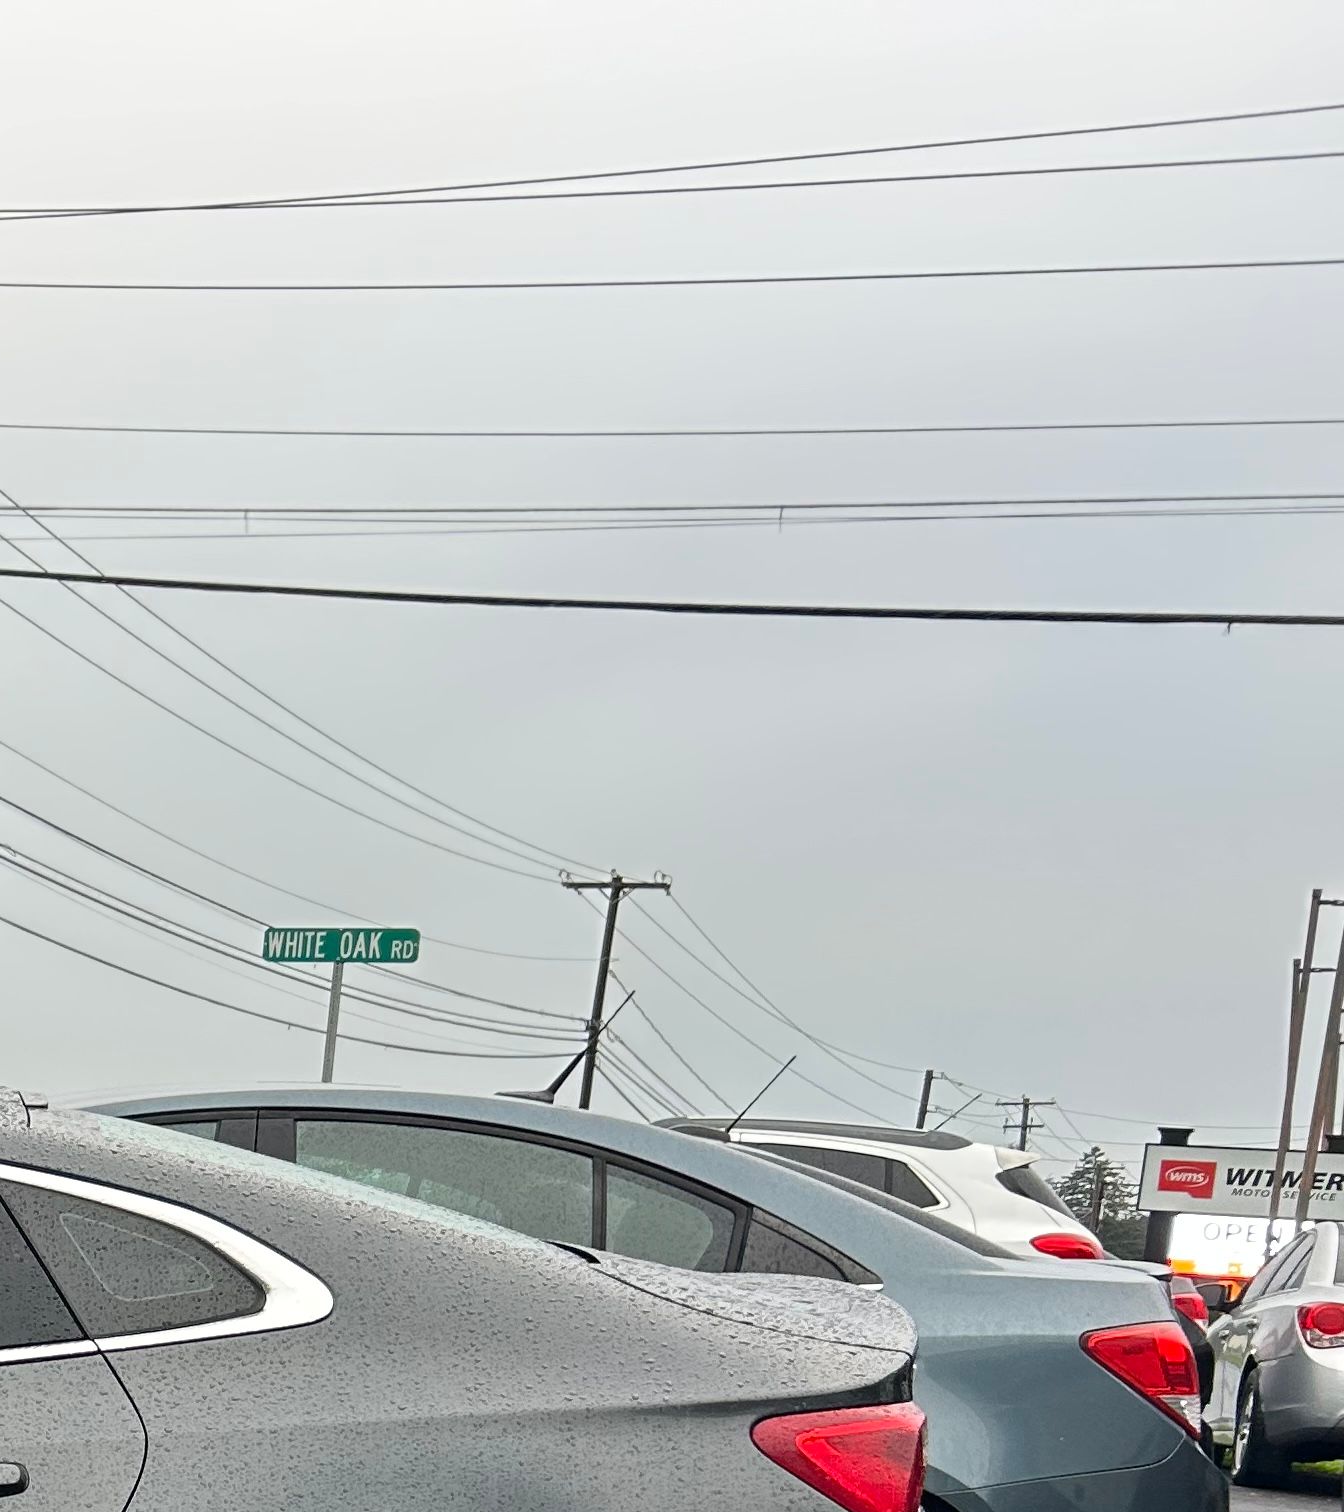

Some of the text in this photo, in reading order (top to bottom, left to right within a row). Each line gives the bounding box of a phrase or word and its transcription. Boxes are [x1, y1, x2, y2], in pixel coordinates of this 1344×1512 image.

[268, 931, 414, 959] WHITE OAK RD
[1226, 1167, 1344, 1192] WITMER
[1231, 1187, 1336, 1202] MOTO SEVICE
